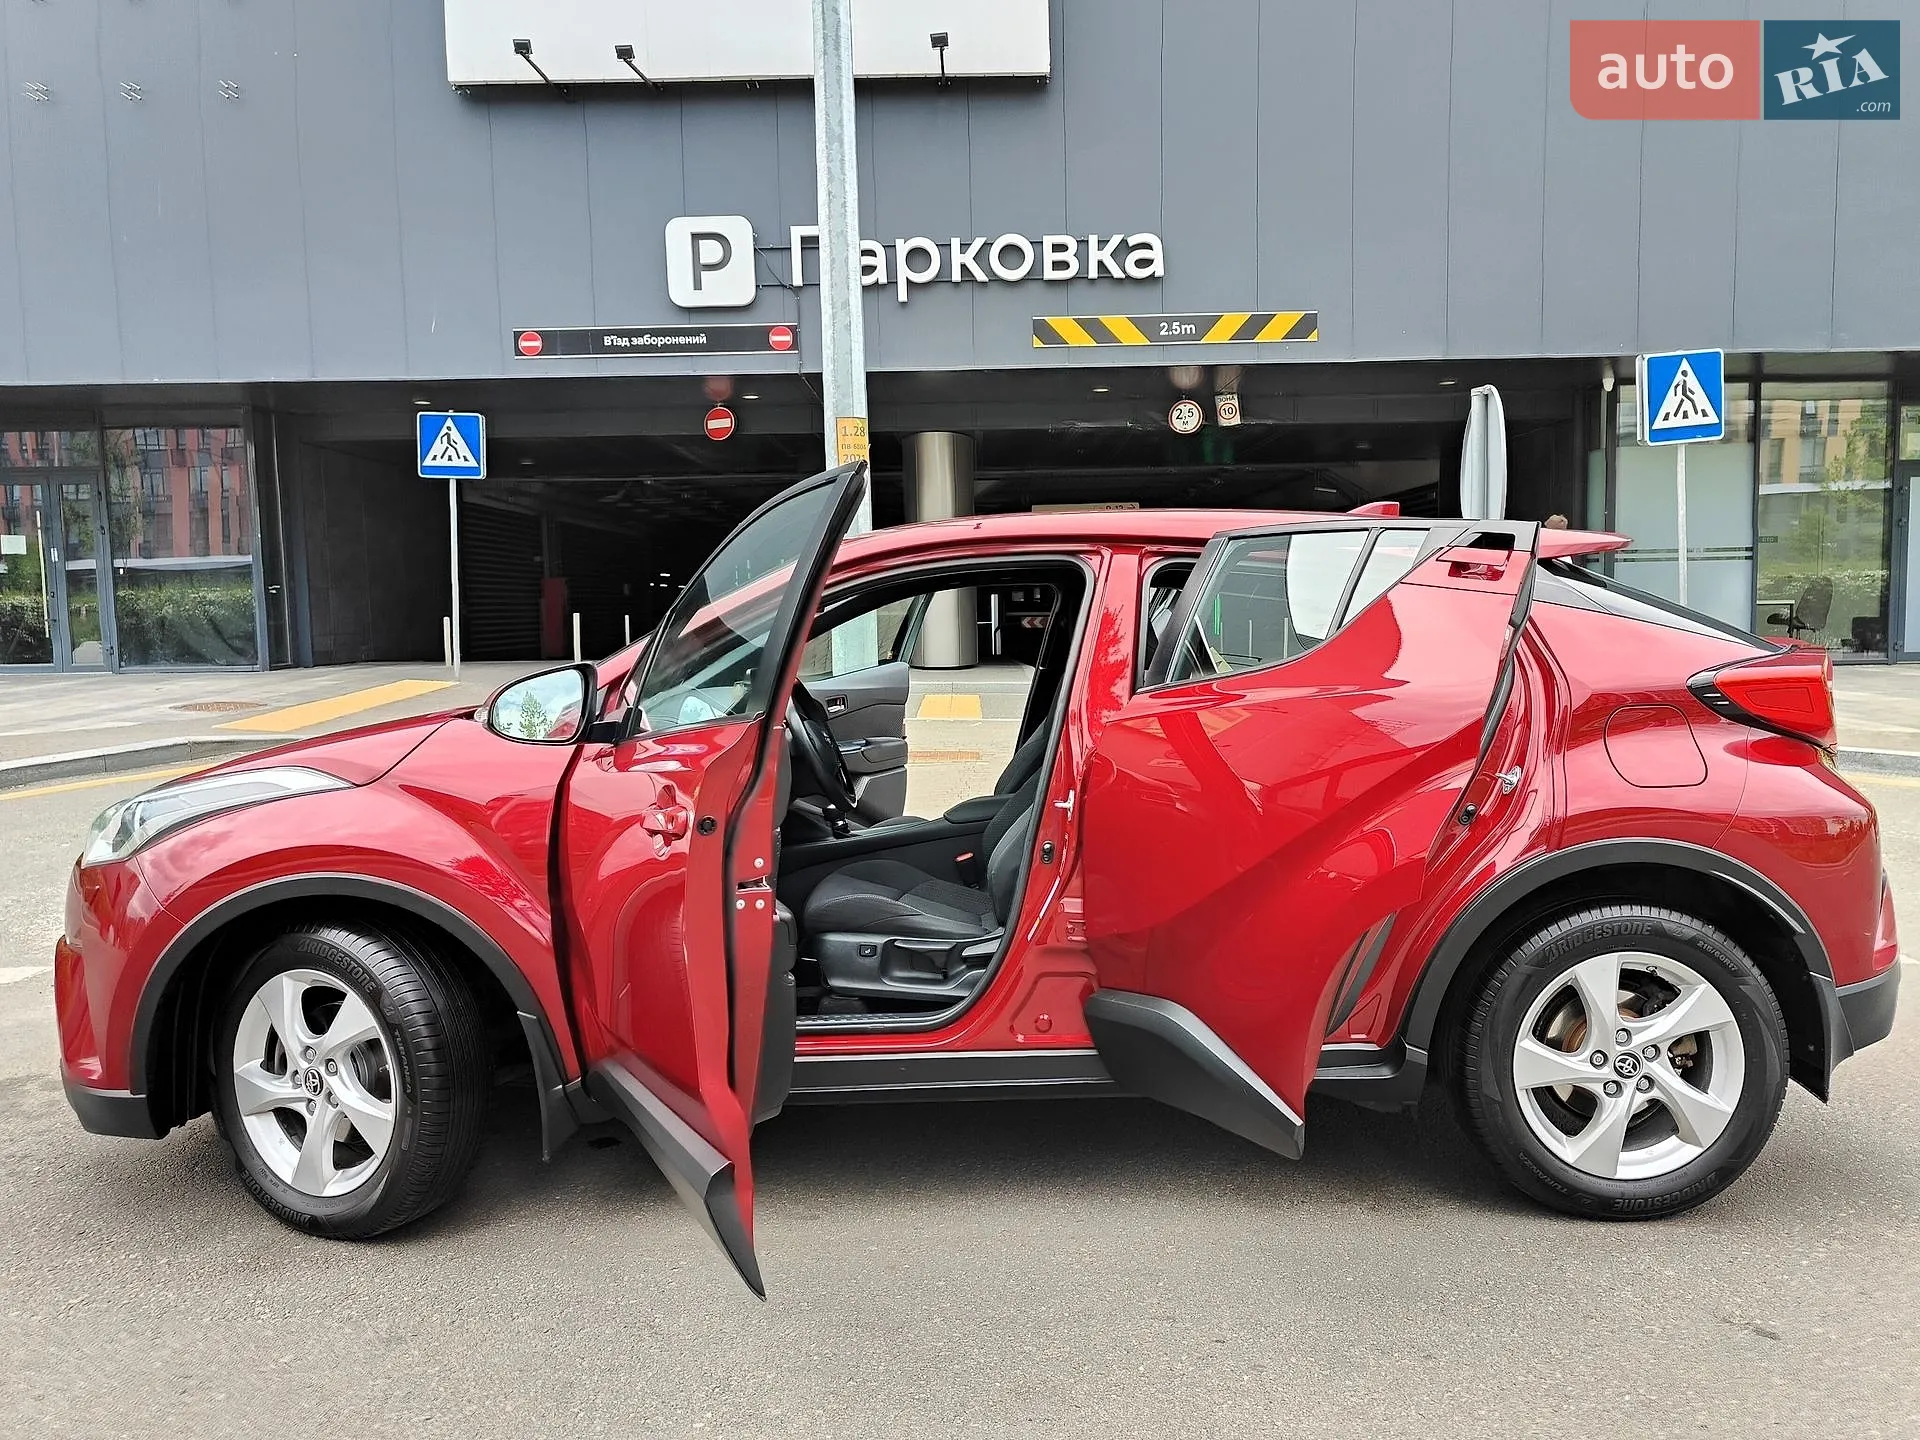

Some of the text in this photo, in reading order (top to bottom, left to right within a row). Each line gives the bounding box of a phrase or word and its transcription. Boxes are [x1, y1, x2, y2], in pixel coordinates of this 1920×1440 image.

[690, 231, 733, 291] P
[789, 225, 1166, 303] Парковка
[1159, 321, 1196, 336] 2.5m
[631, 333, 707, 348] заборонений
[1175, 407, 1194, 420] 2,5
[1222, 406, 1234, 416] 10
[841, 425, 866, 437] 1.28
[1544, 921, 1652, 964] BRIDGESTONE
[297, 938, 376, 995] BRIDGESTONE
